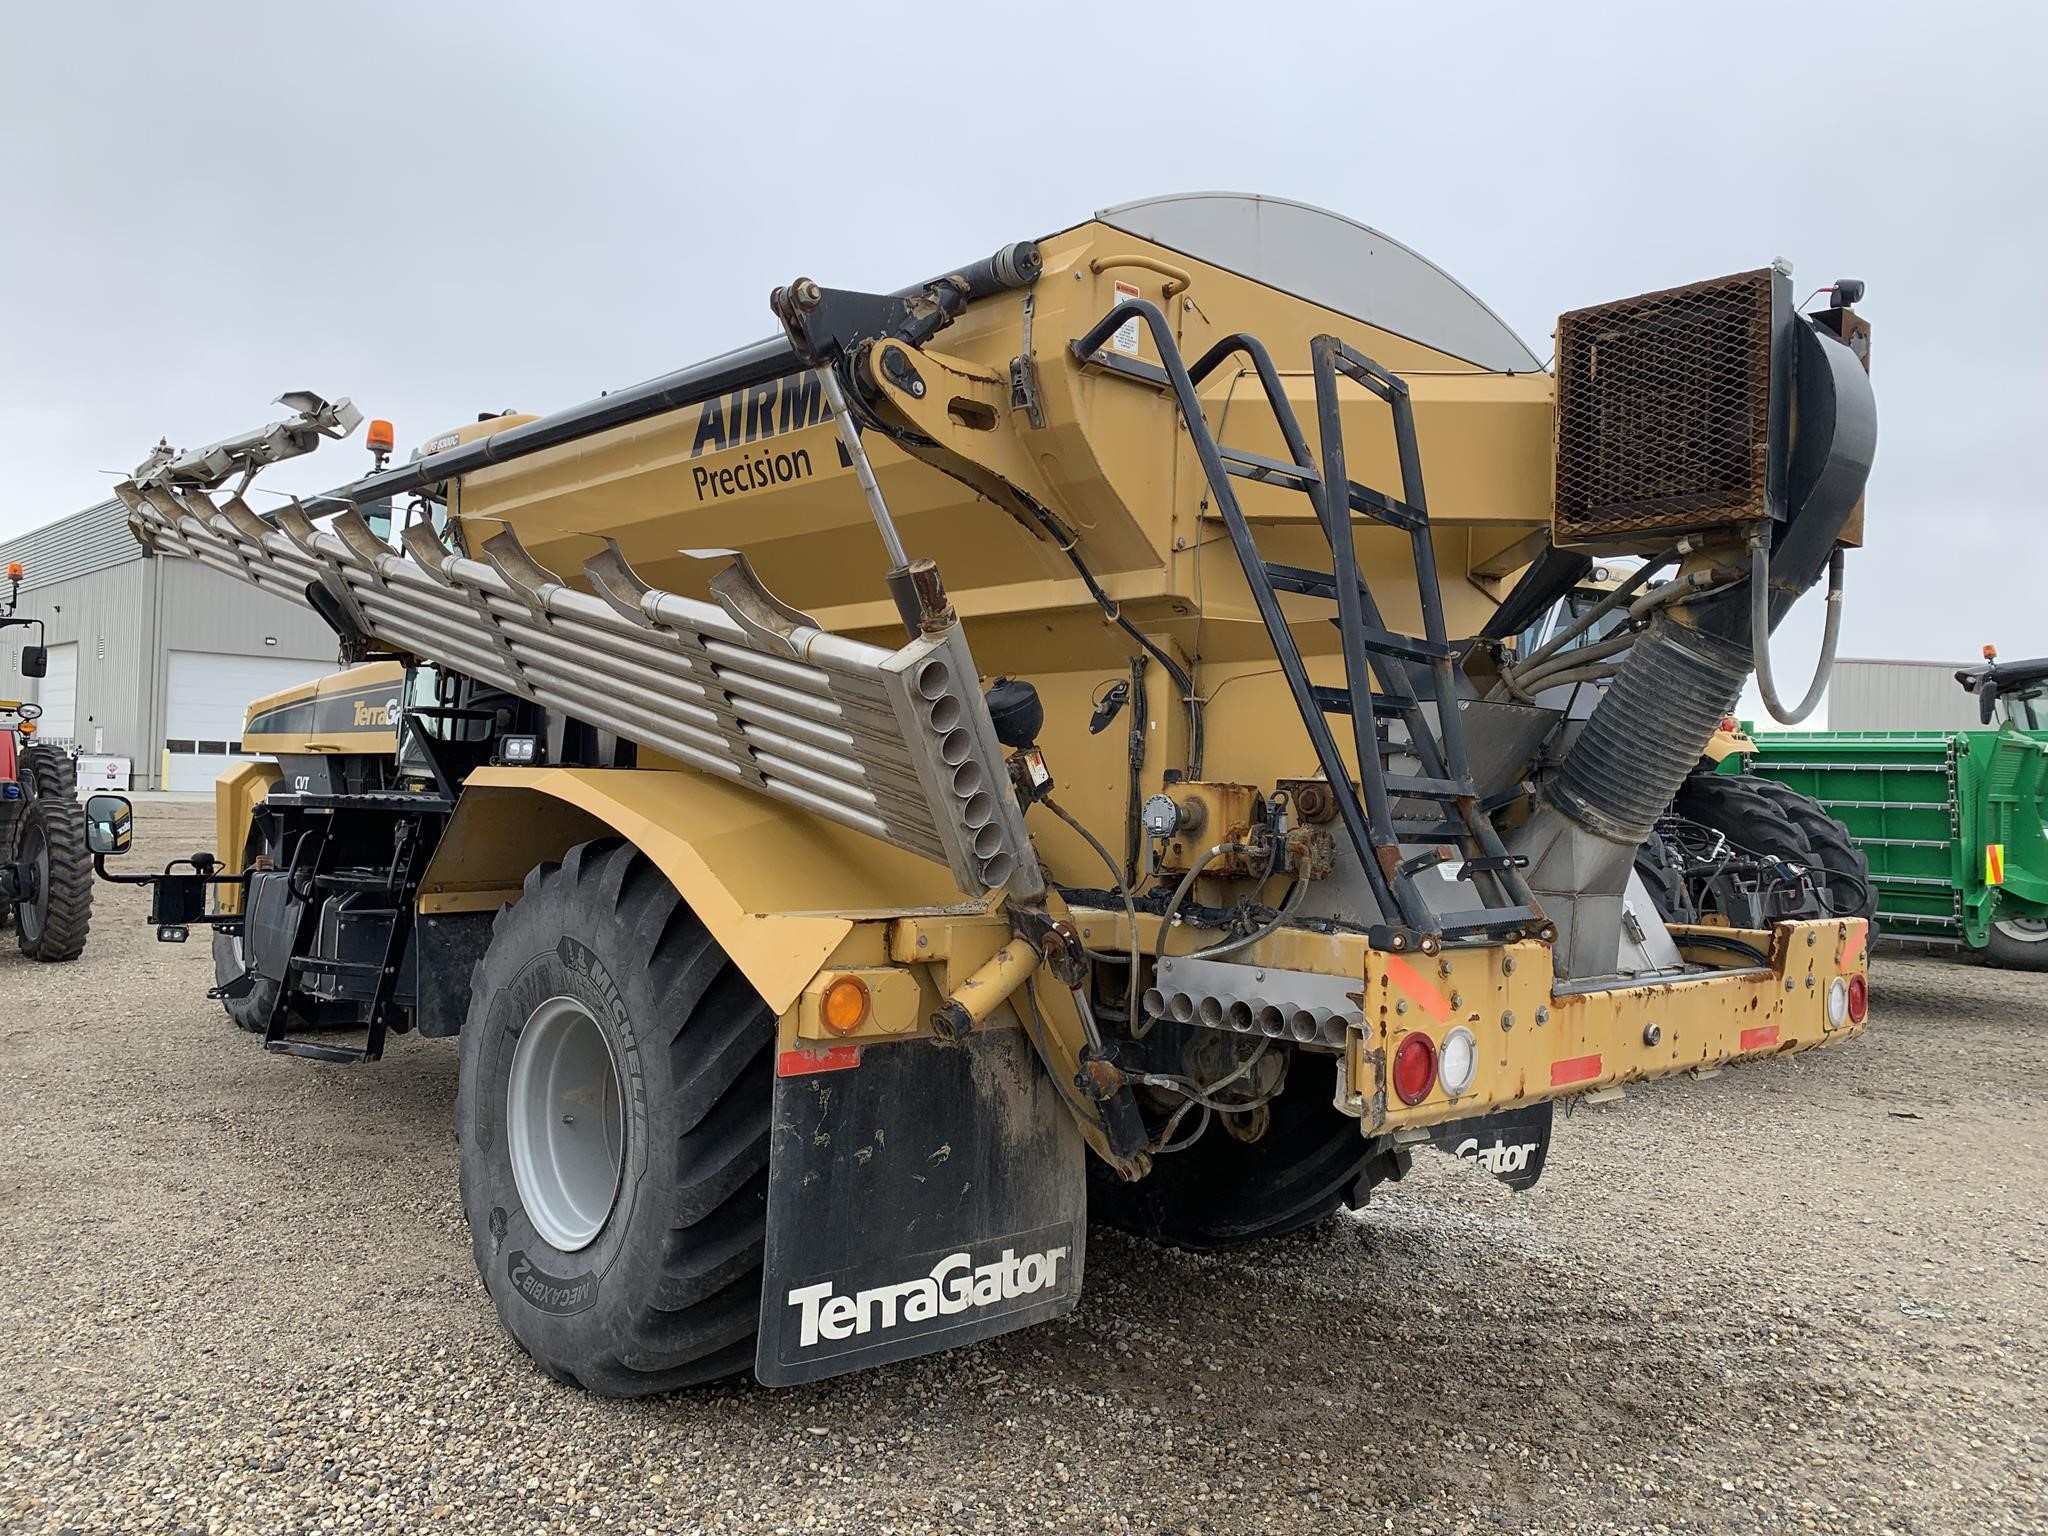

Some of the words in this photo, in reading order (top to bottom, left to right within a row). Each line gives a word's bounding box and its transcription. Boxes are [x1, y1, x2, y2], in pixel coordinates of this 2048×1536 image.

[690, 369, 836, 458] AIRM
[693, 449, 813, 501] Precision
[295, 776, 310, 790] CVT
[511, 1257, 532, 1286] 2
[522, 1275, 590, 1307] MEGAXBIB
[788, 1252, 1067, 1347] TerraGator
